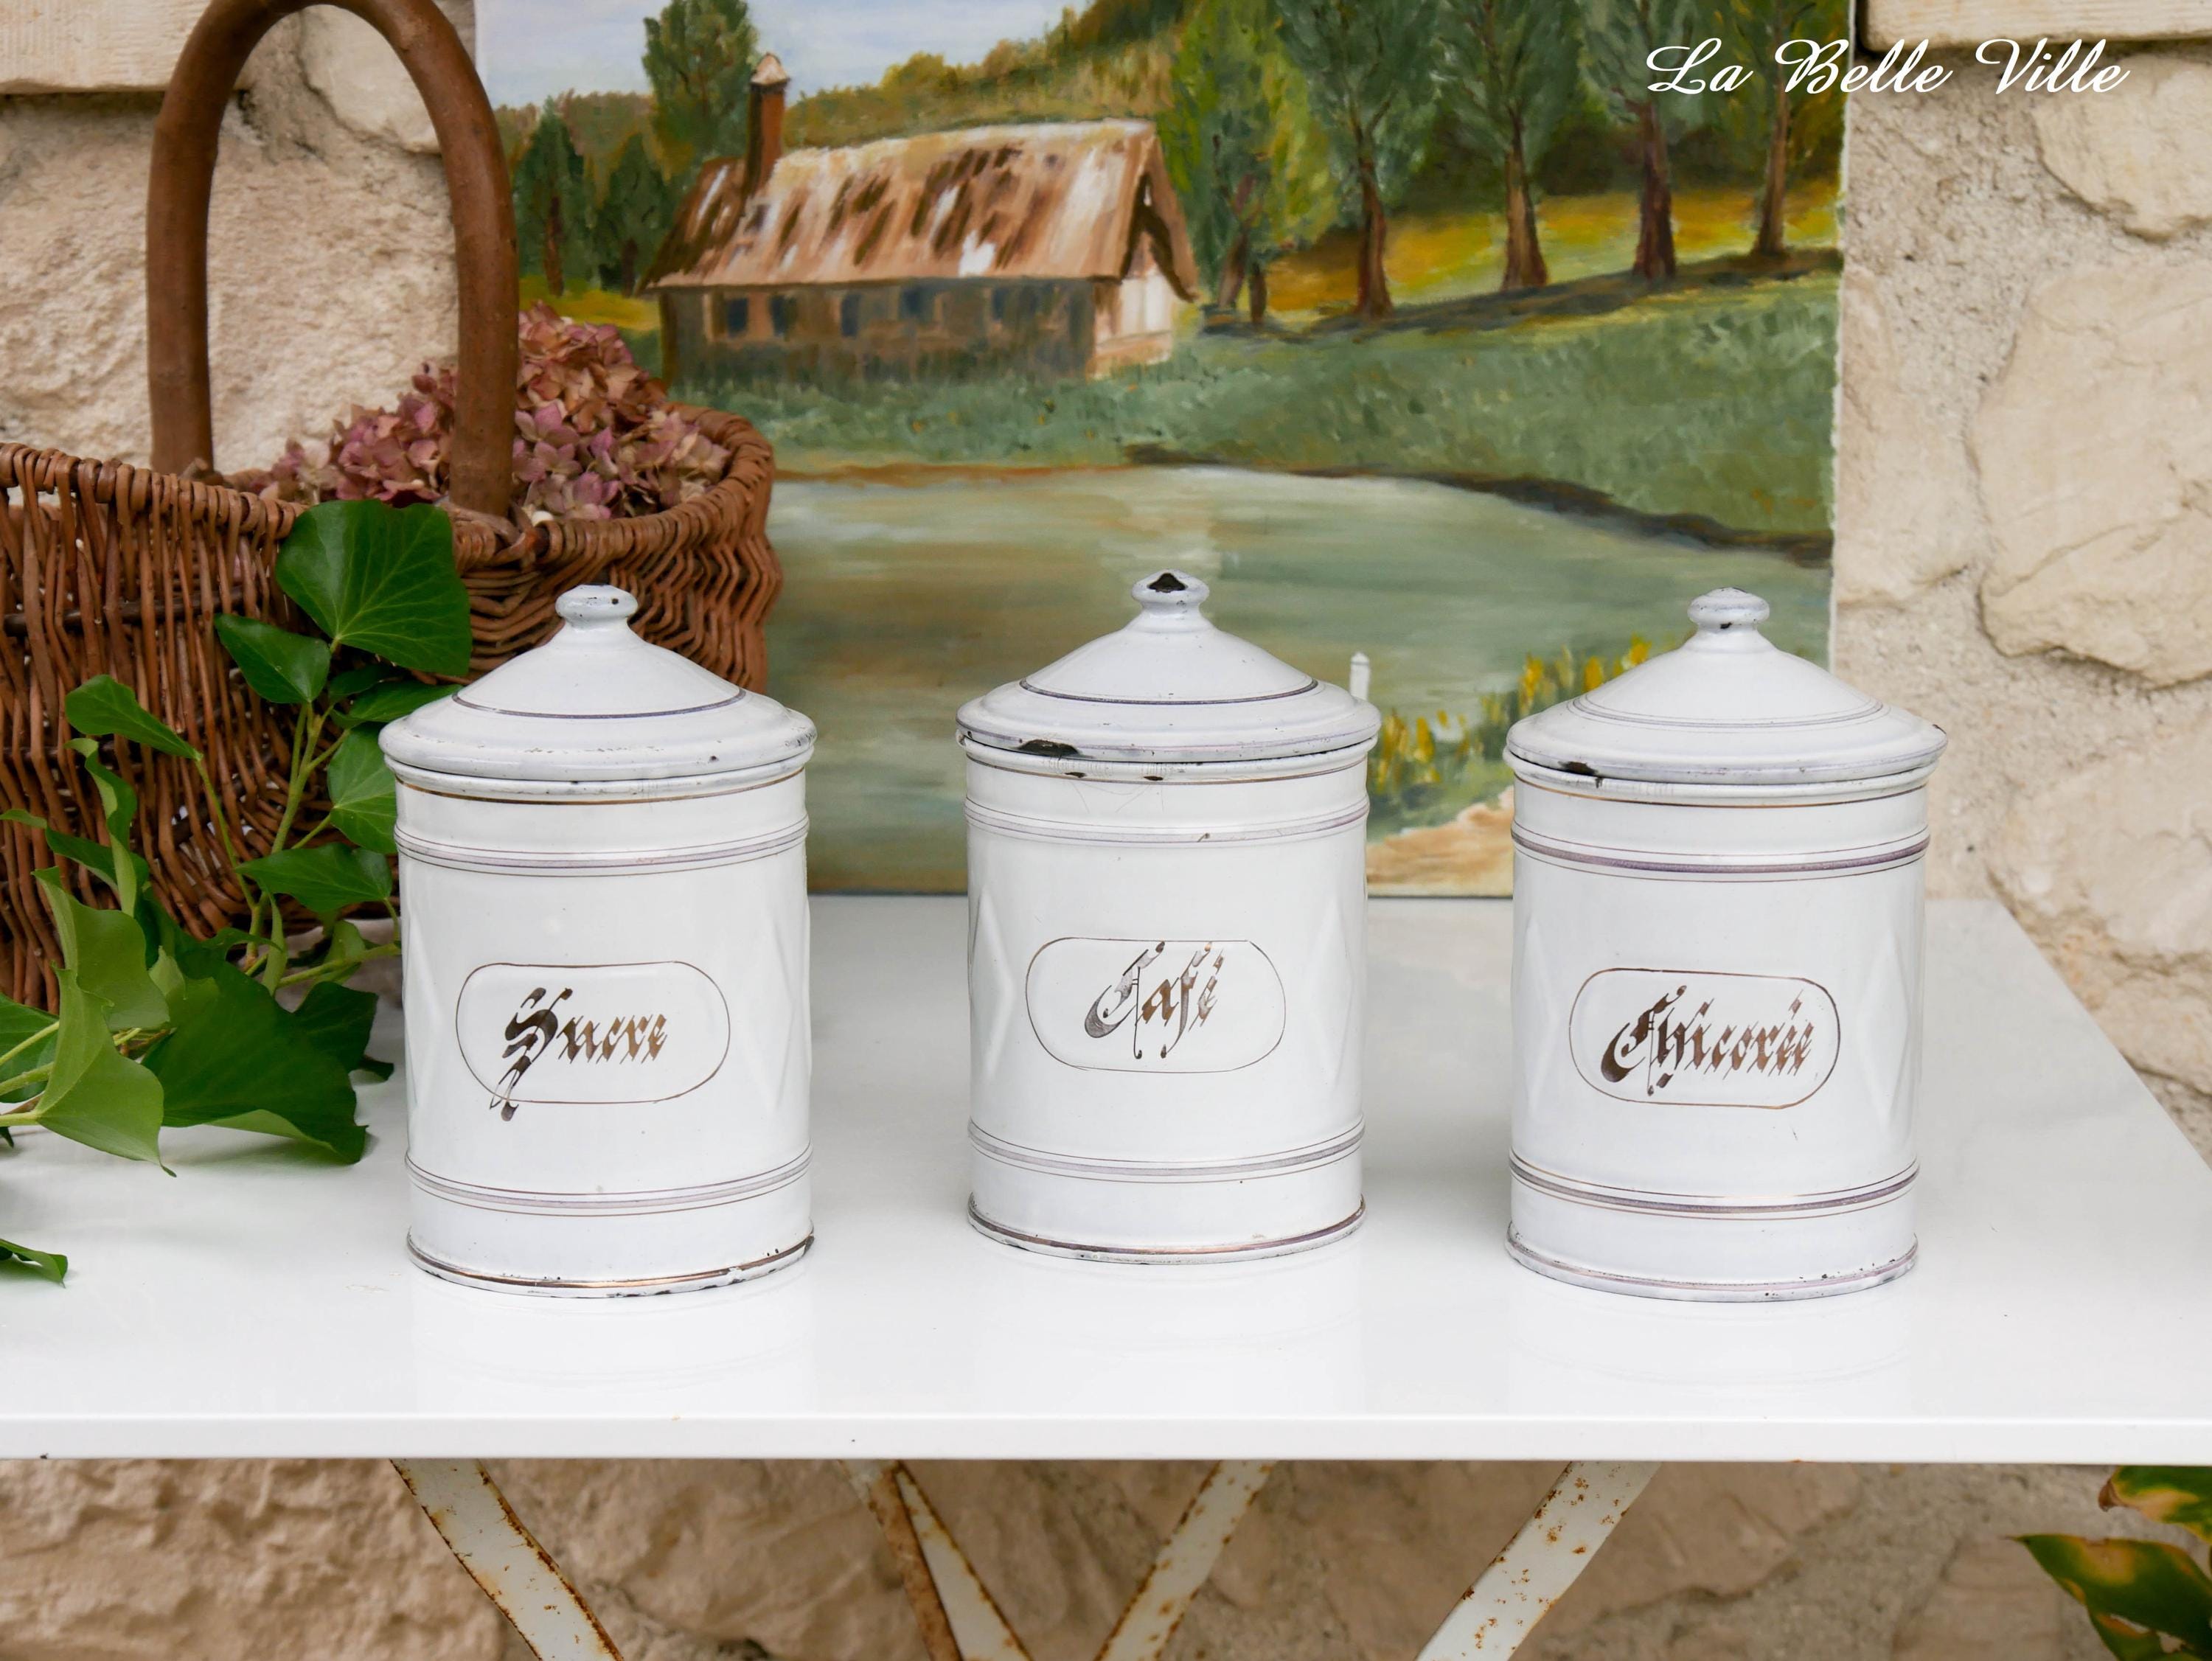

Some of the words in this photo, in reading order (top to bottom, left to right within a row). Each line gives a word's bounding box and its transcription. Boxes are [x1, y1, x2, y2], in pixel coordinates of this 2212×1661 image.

[489, 986, 668, 1122] Sucre
[1084, 941, 1225, 1060] Café
[1600, 985, 1815, 1096] Chicorée
